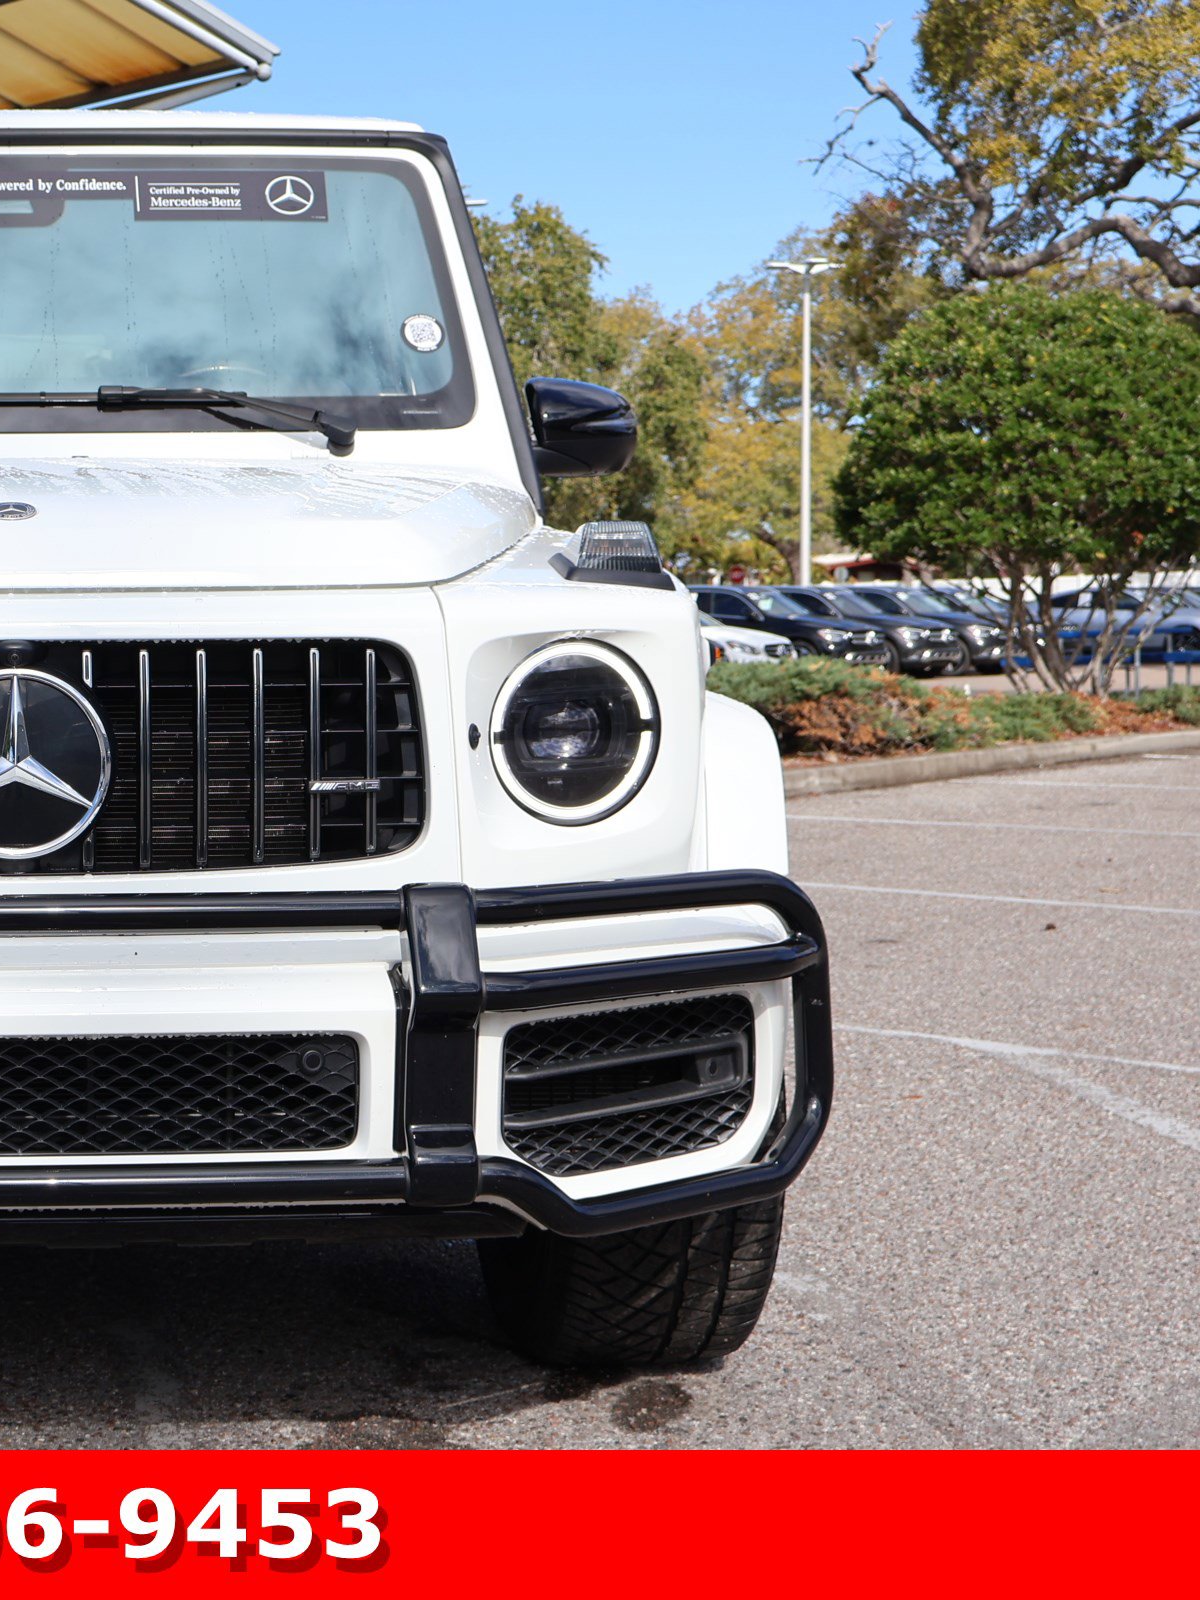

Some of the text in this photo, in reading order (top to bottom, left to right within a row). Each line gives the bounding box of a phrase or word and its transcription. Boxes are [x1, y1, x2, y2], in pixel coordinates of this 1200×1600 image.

[38, 178, 52, 193] by
[56, 178, 126, 191] Confidence.
[149, 186, 240, 196] Certified Pre-Owned by
[150, 197, 241, 207] Mercedes-Benz
